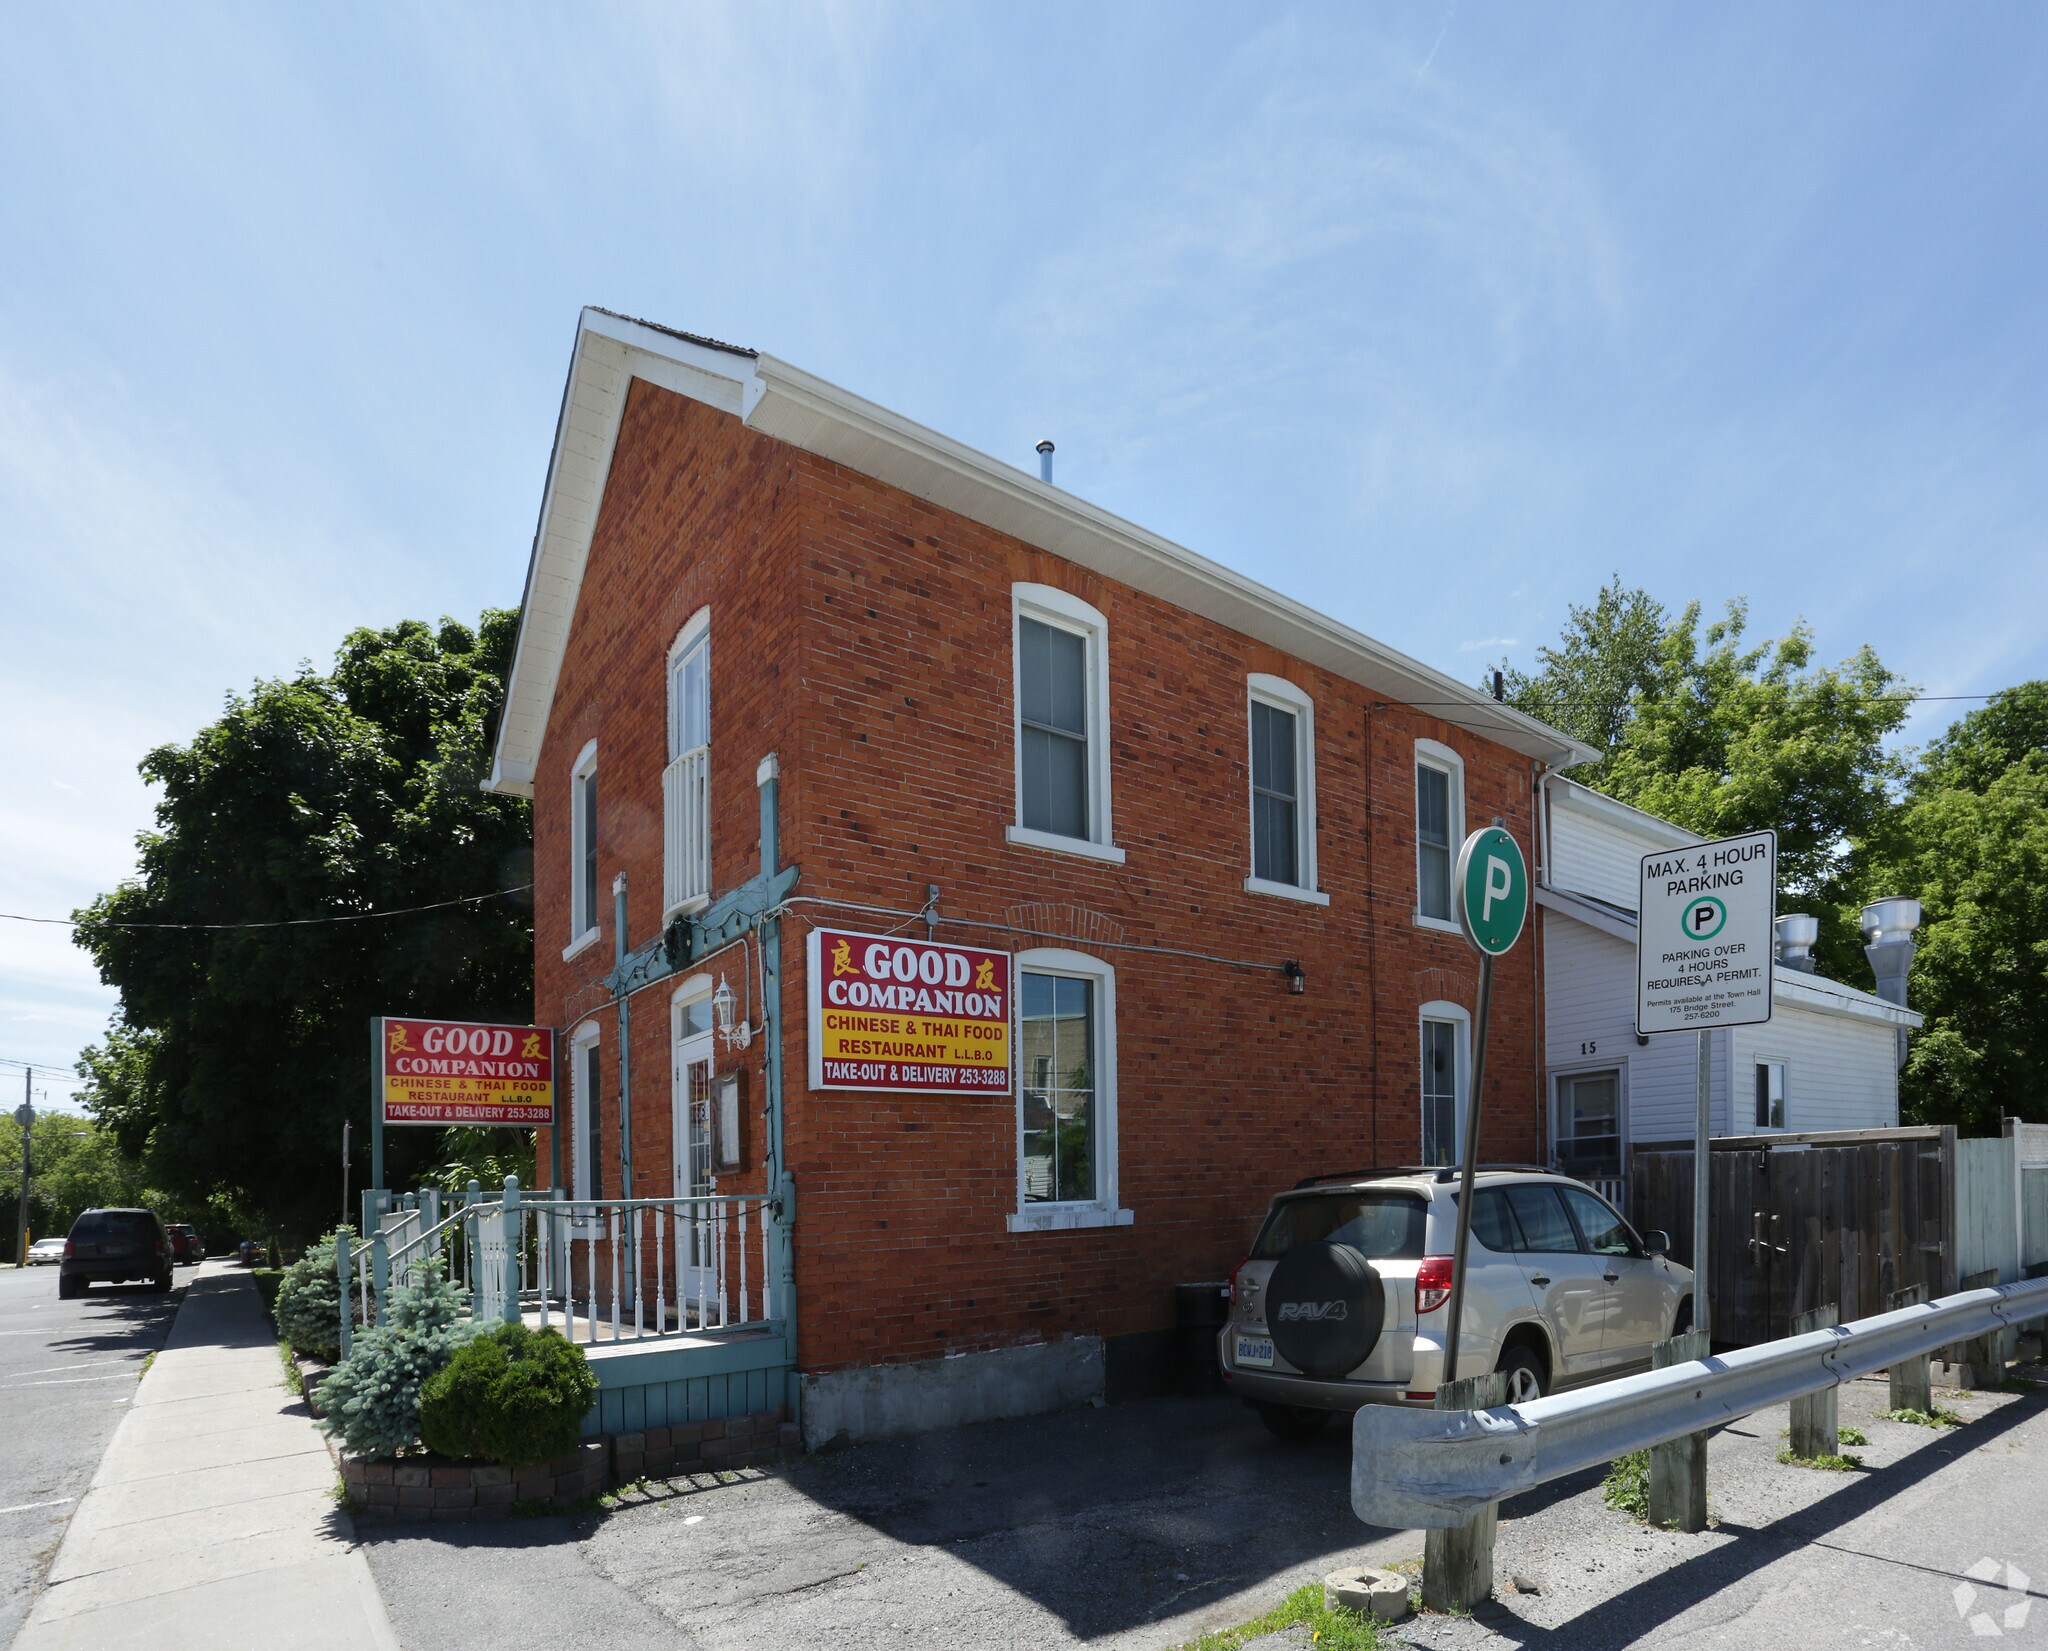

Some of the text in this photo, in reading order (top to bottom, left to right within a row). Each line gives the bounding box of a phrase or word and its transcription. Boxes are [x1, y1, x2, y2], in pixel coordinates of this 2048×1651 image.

[1648, 843, 1765, 879] MAX. 4 HOUR
[1483, 854, 1512, 922] P
[1667, 870, 1743, 896] PARKING
[1696, 907, 1714, 930] P
[831, 940, 860, 976] 良
[1663, 944, 1745, 963] PARKING OVER
[865, 944, 970, 987] GOOD
[976, 959, 1002, 992] 友
[1678, 959, 1728, 974] 4 HOURS
[1648, 968, 1761, 990] REQUIRES A PERMIT.
[828, 980, 1002, 1018] COMPANION
[1674, 996, 1702, 1004] available
[1684, 1003, 1708, 1012] Bridge
[1685, 1011, 1719, 1020] 257-6200
[388, 1024, 416, 1054] 良
[827, 1015, 1003, 1041] CHINESE & THAI FOOD
[423, 1026, 513, 1056] GOOD
[521, 1032, 549, 1060] 友
[839, 1039, 992, 1060] RESTAURANT L.L.B.O
[1581, 1041, 1596, 1054] 15
[395, 1058, 539, 1077] COMPANION
[825, 1062, 1005, 1085] TAKE-OUT & DELIVERY 253-3288
[391, 1078, 546, 1092] CHINESE & THAI FOOD
[409, 1091, 490, 1102] RESTAURANT
[388, 1105, 550, 1119] TAKE-OUT & DELIVERY 253-3288
[1278, 1300, 1348, 1321] RAV4
